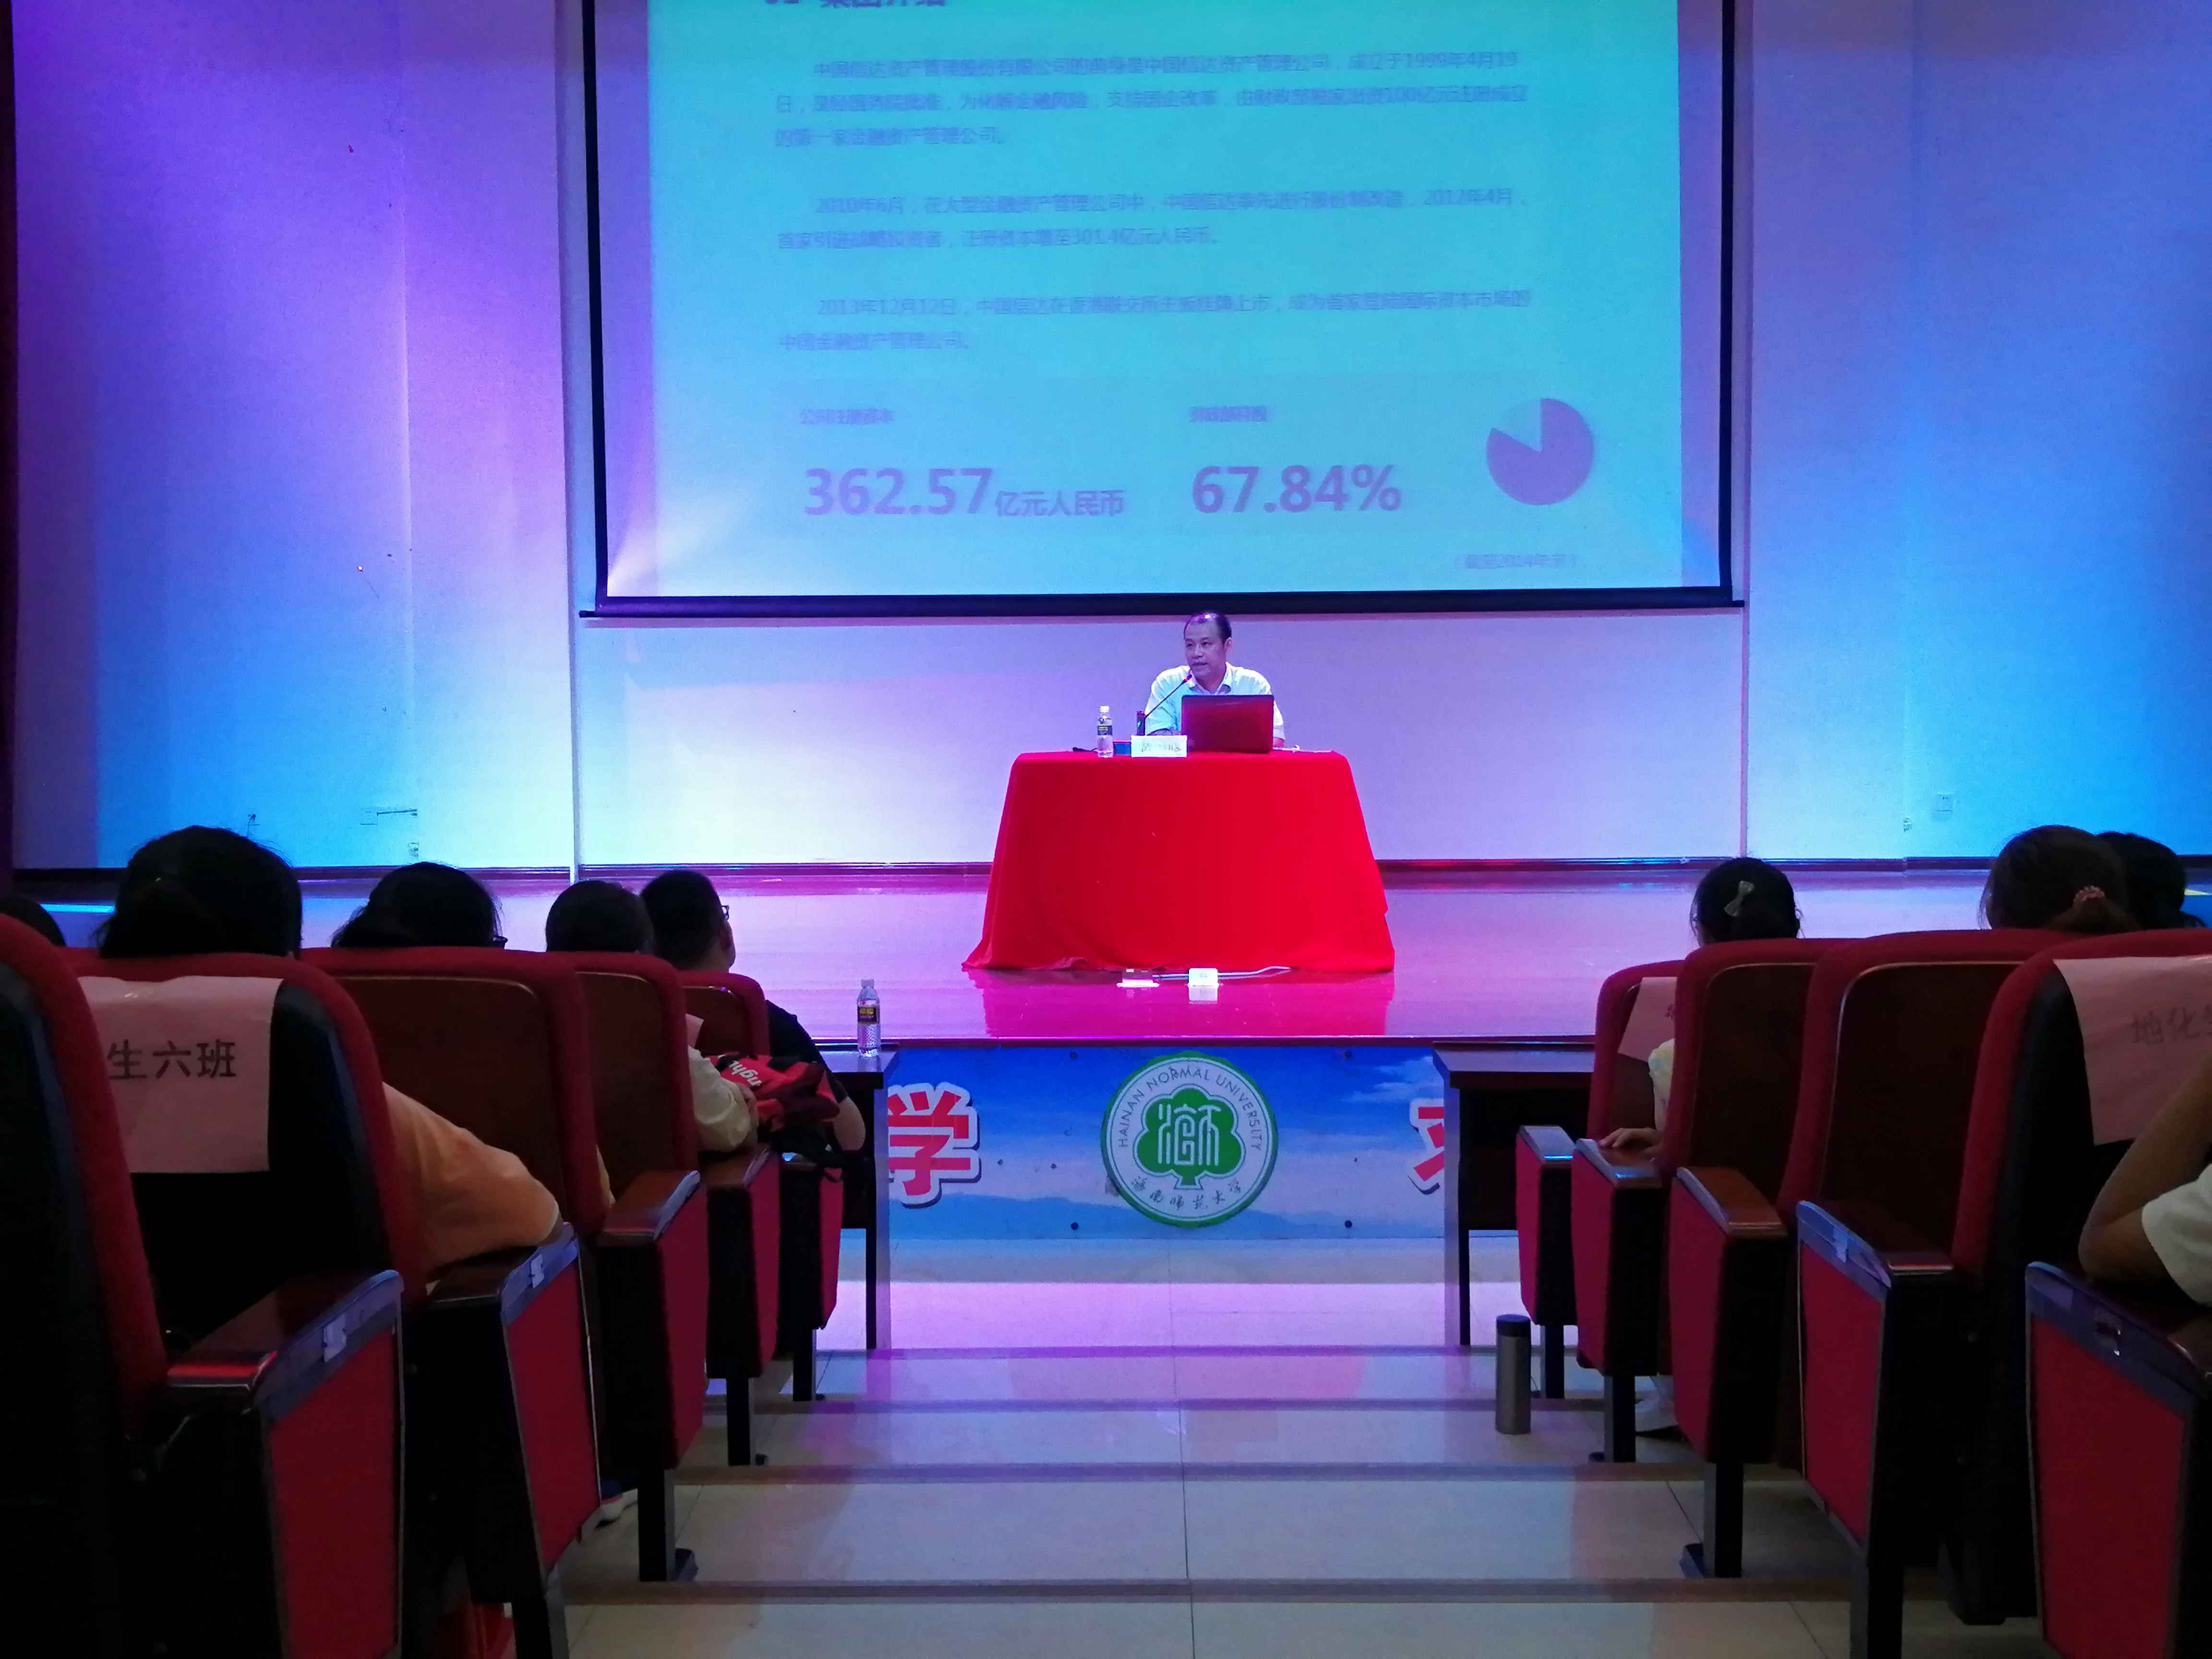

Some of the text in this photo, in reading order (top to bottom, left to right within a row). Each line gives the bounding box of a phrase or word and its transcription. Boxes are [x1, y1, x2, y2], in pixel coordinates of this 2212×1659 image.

[1191, 464, 1402, 514] 67.84%
[108, 1038, 236, 1080] 生六班
[1118, 1065, 1263, 1151] HAINAN NORMAL UNIVERSITY
